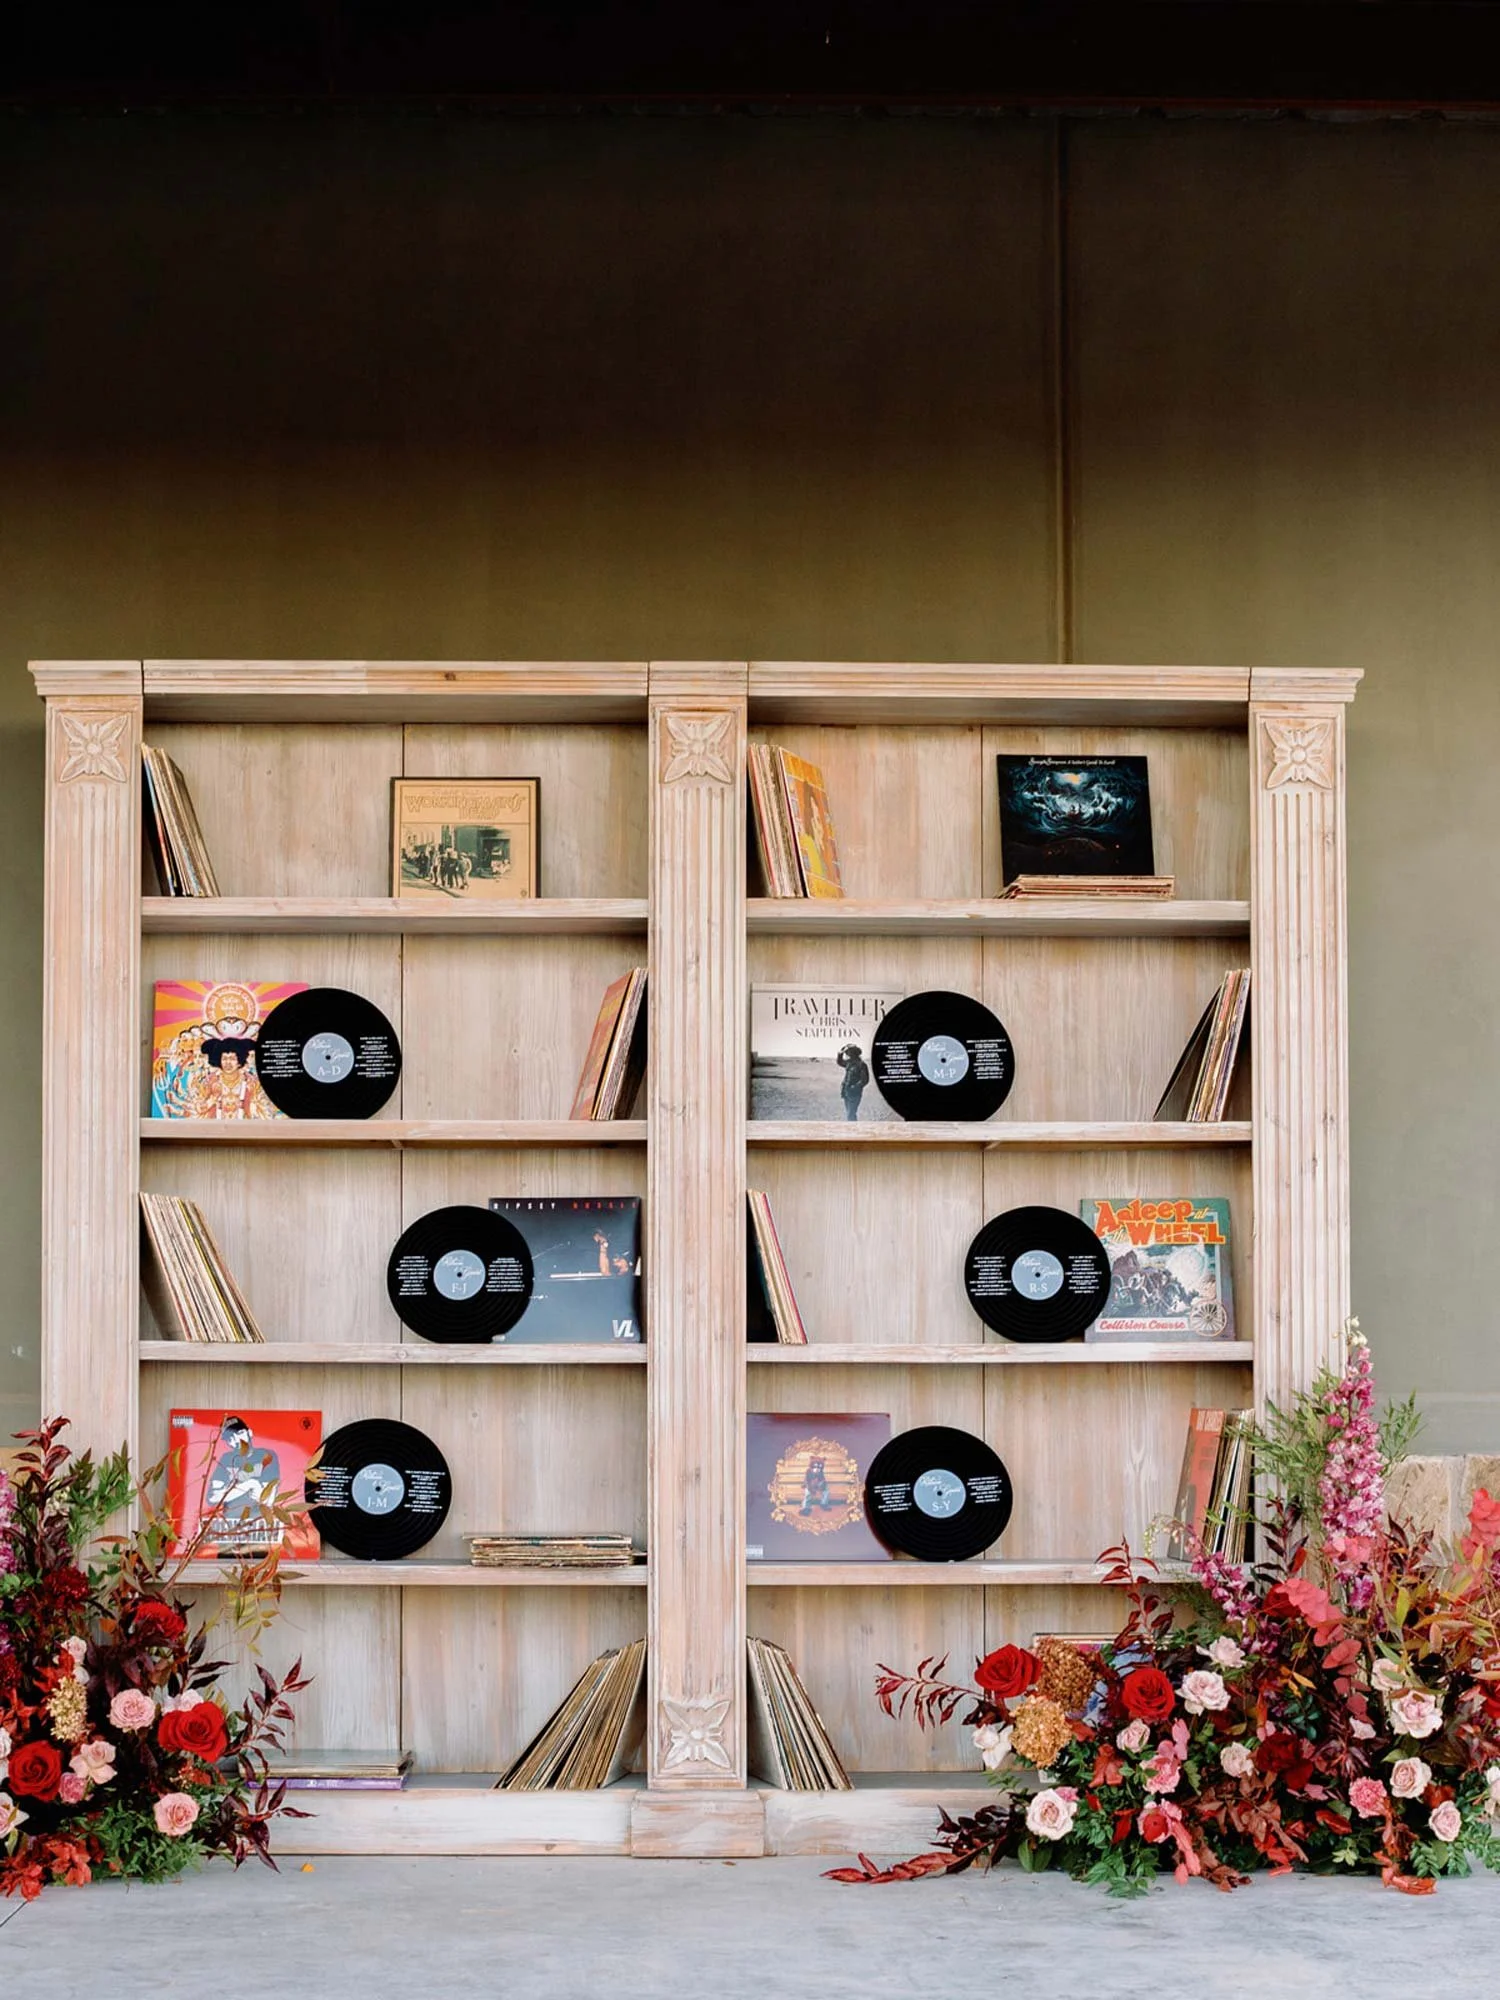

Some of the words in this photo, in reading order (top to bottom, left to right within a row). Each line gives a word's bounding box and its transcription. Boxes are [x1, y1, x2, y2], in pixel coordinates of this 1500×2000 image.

[811, 1016, 846, 1027] CHRIS
[317, 1066, 341, 1076] A-D
[933, 1069, 957, 1079] M-P
[1126, 1220, 1226, 1246] WHEEL
[1029, 1283, 1048, 1293] R-S
[932, 1501, 951, 1512] S-Y
